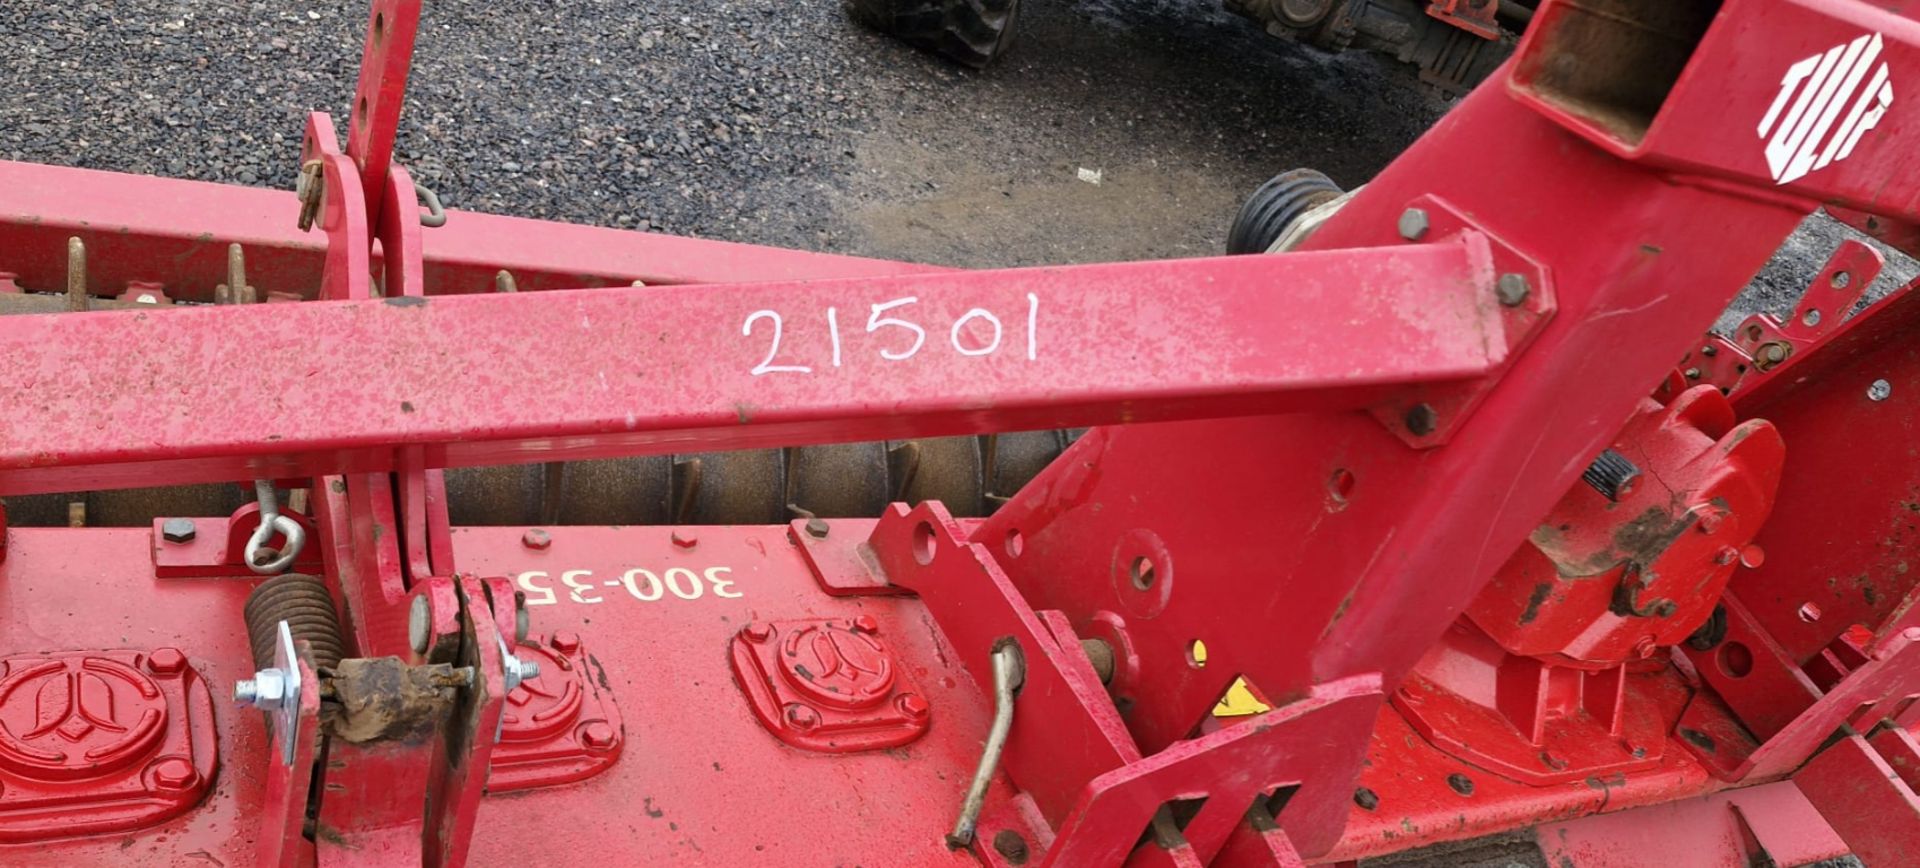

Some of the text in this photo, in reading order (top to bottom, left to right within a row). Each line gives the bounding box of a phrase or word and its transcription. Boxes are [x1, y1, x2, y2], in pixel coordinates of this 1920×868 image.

[1757, 31, 1894, 186] TULIP
[742, 292, 1039, 376] 21501
[517, 566, 744, 606] 300-35
